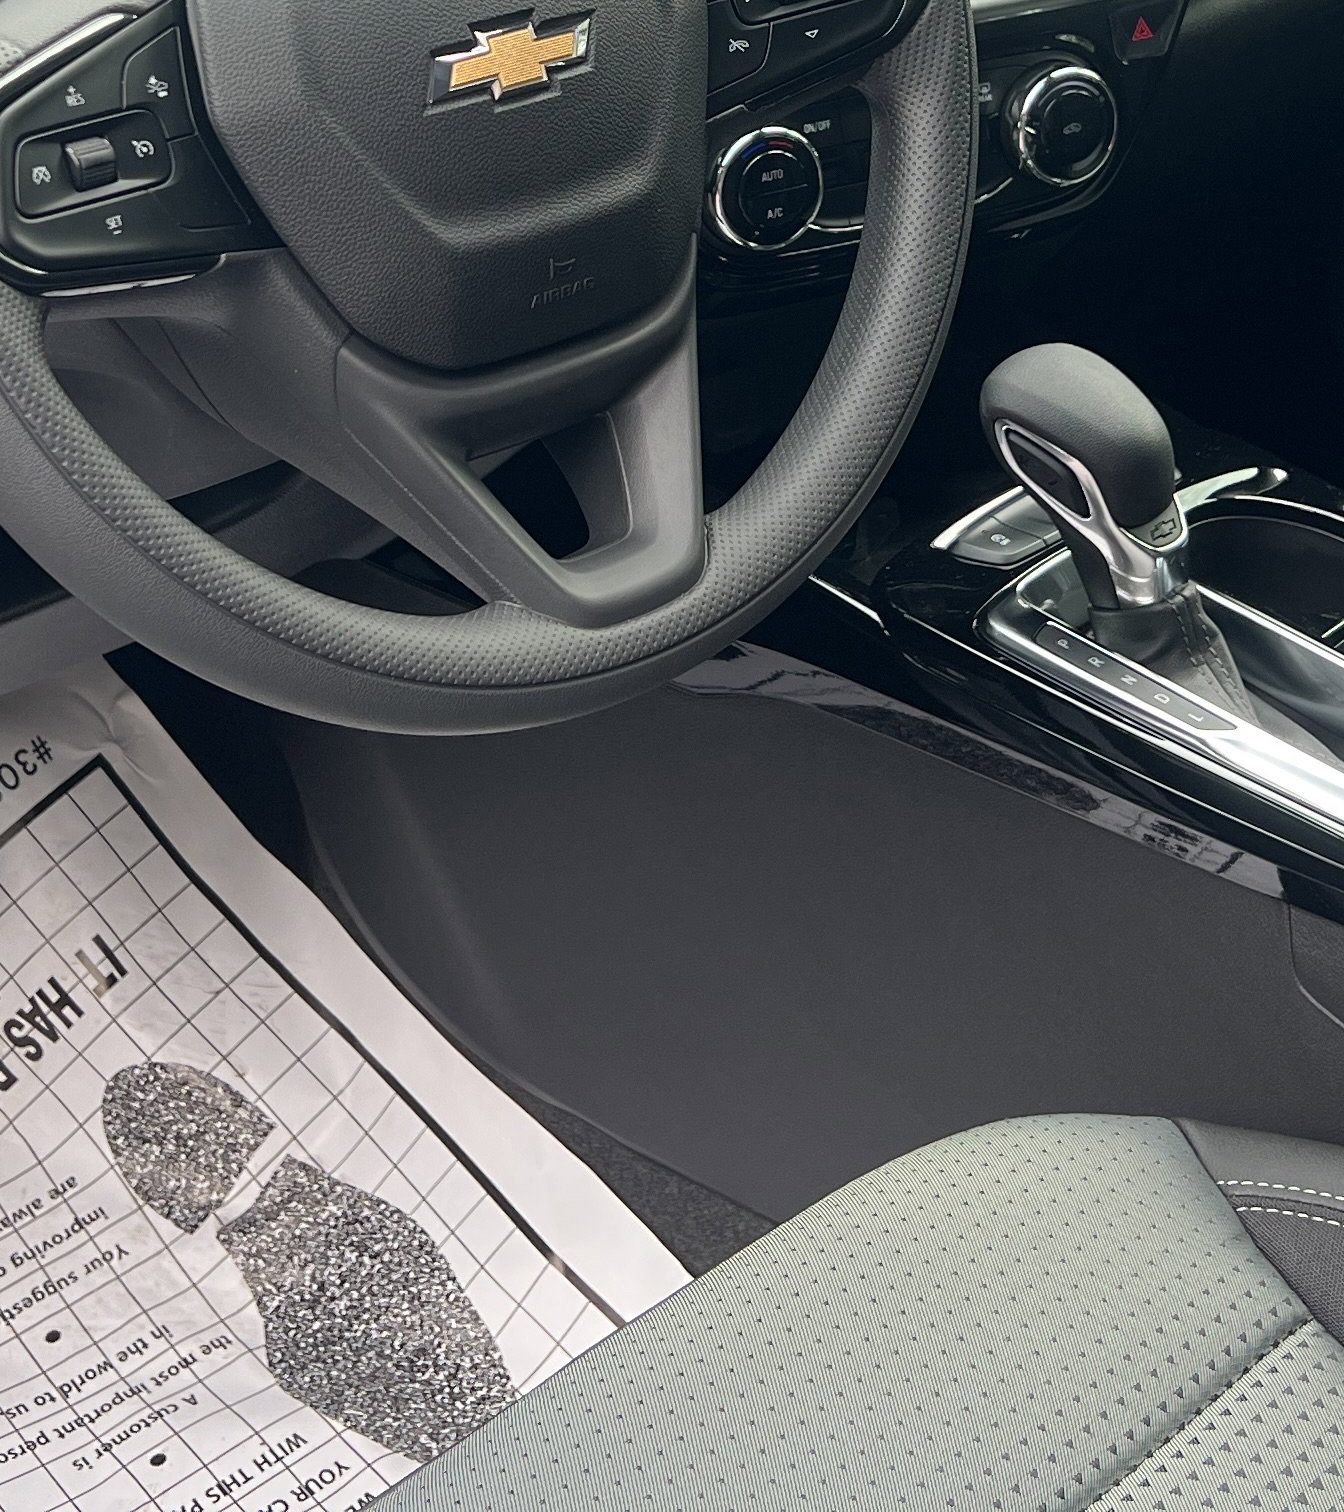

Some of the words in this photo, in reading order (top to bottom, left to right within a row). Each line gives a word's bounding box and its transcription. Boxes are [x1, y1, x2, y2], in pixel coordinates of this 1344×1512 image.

[803, 119, 831, 134] ON/OFF
[761, 168, 784, 183] AUTO
[767, 207, 784, 220] A/C
[1057, 638, 1070, 650] P
[1088, 656, 1106, 668] R
[1120, 674, 1138, 686] N
[1153, 693, 1170, 704] D
[1187, 712, 1204, 723] L
[74, 933, 128, 999] IT
[3, 976, 86, 1062] HAS
[47, 1176, 78, 1201] are
[10, 1206, 110, 1269] improving
[83, 1243, 130, 1277] Your
[149, 1324, 174, 1340] in
[199, 1335, 233, 1356] the
[116, 1337, 149, 1363] the
[59, 1360, 115, 1399] world
[150, 1353, 198, 1387] most
[34, 1390, 56, 1406] to
[53, 1382, 153, 1439] important
[181, 1393, 199, 1406] A
[95, 1402, 180, 1460] customer
[72, 1456, 94, 1471] is
[253, 1432, 308, 1473] WITH
[205, 1469, 254, 1504] THIS
[290, 1461, 351, 1502] YOUR
